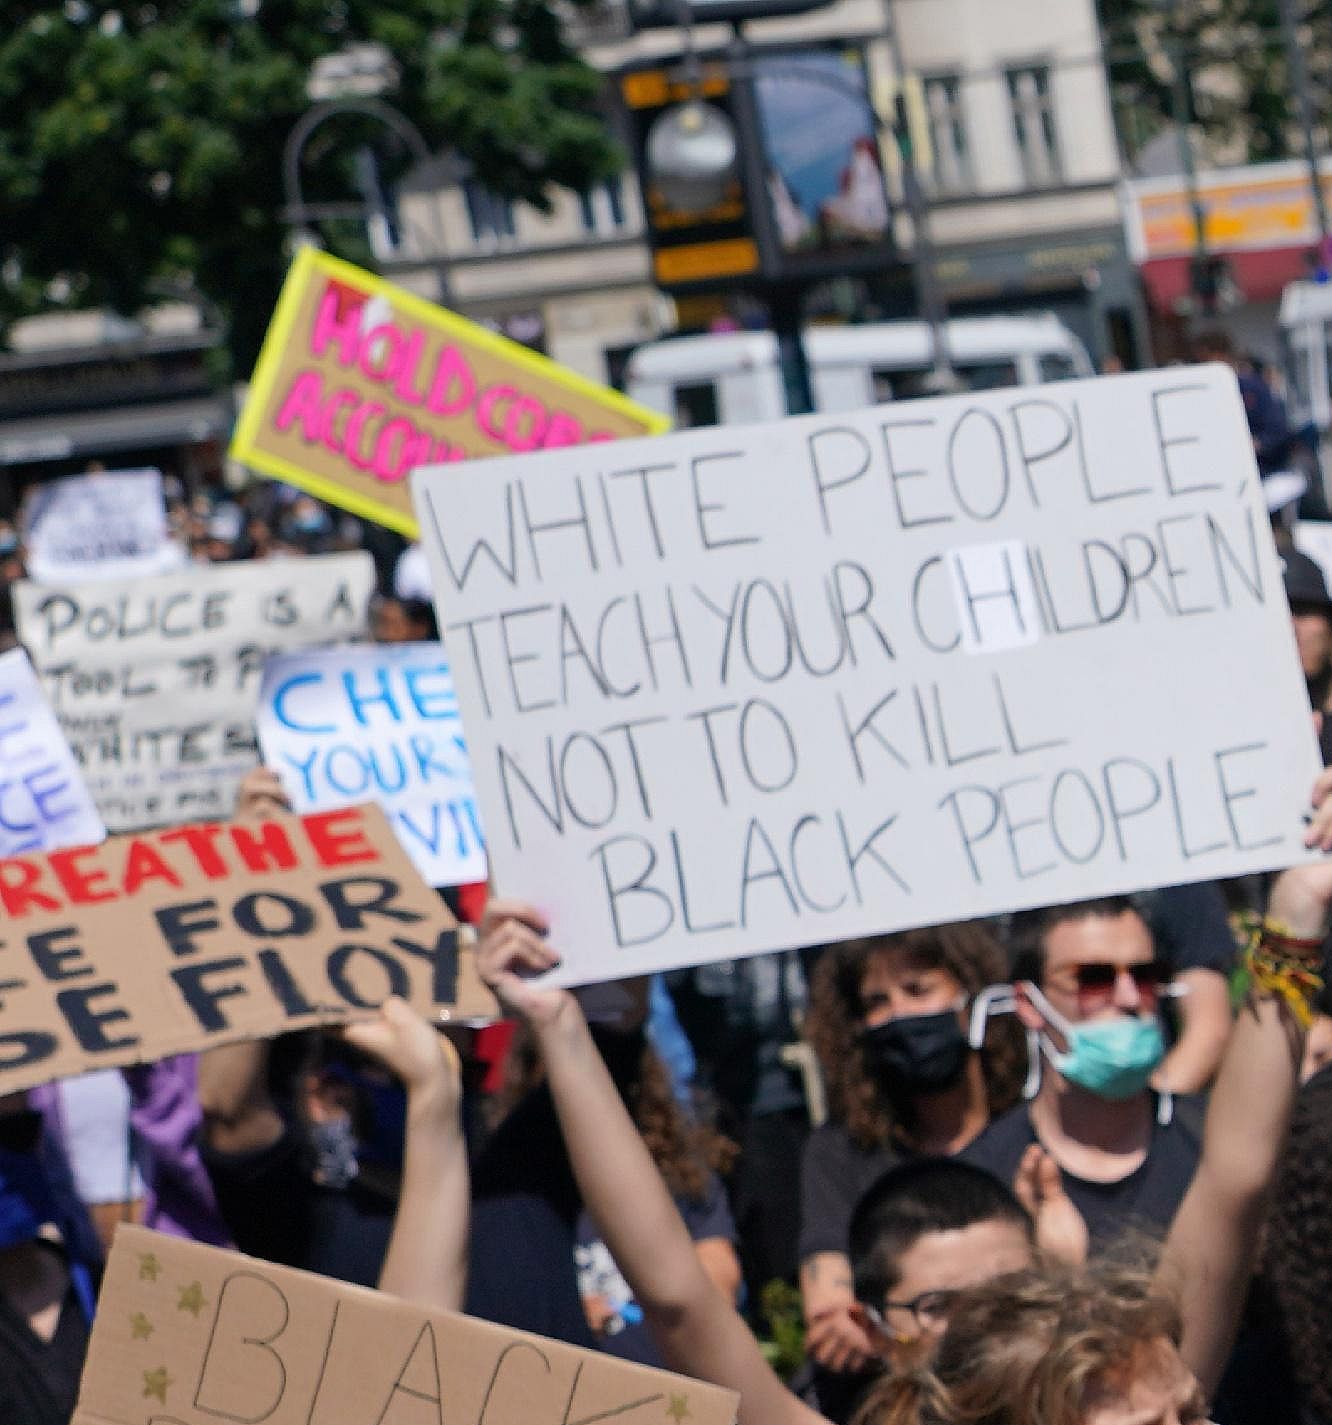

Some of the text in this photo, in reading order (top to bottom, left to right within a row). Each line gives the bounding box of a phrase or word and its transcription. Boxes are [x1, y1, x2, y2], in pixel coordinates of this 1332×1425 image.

[311, 284, 617, 453] HOLD COP
[424, 450, 760, 592] WHITE
[911, 506, 1267, 654] CHILDREN
[37, 590, 233, 652] POLICE
[327, 578, 357, 624] A
[283, 735, 453, 802] YOUR
[497, 673, 1069, 850] NOT TO KILL
[154, 874, 425, 957] FOR
[588, 742, 1284, 949] BLACK PEOPLE
[170, 928, 460, 1033] FLOY
